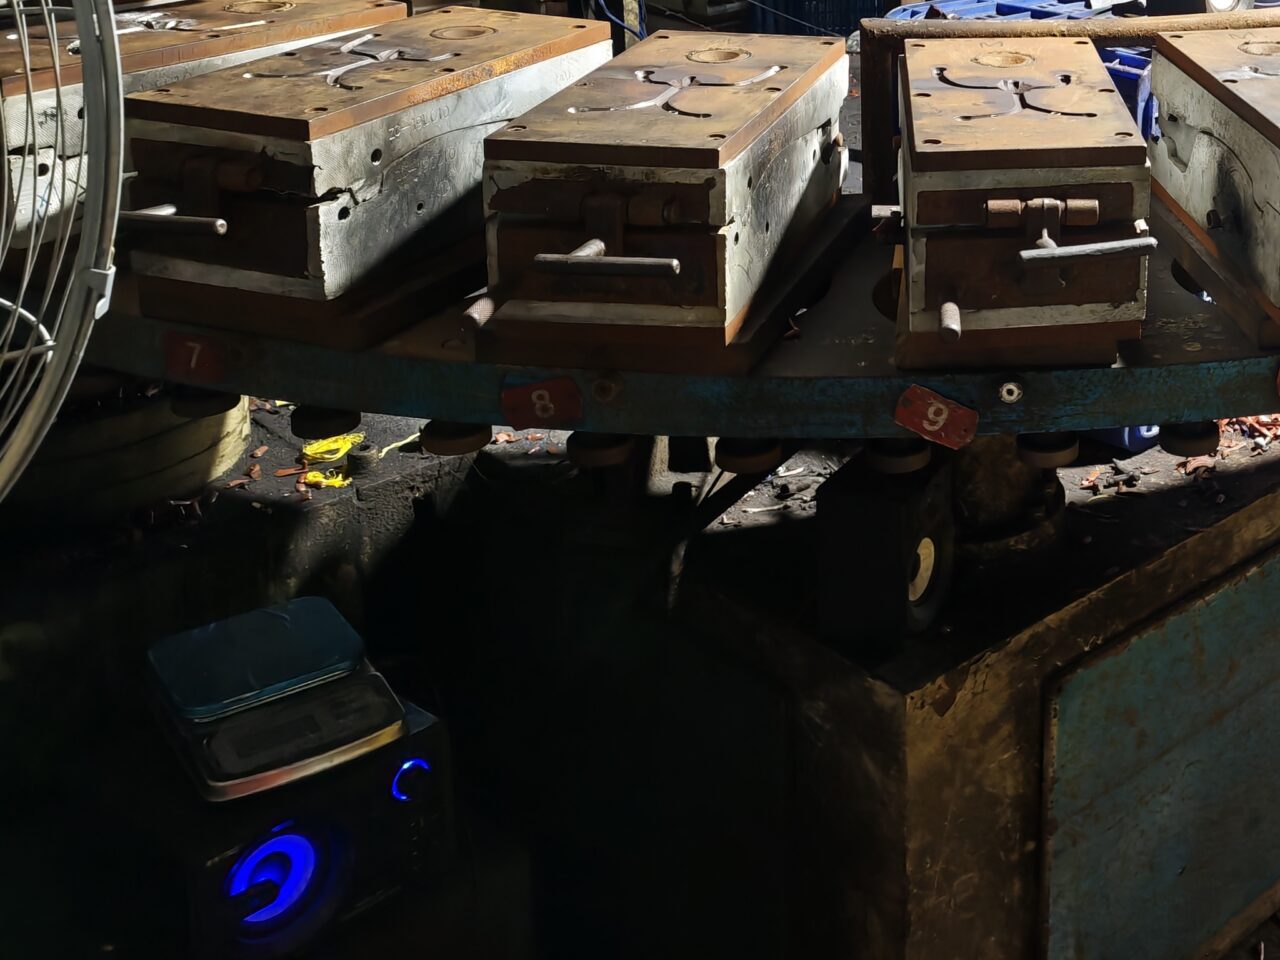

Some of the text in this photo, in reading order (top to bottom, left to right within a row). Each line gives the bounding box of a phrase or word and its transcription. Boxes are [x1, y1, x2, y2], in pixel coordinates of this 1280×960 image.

[184, 341, 202, 370] 7
[530, 388, 555, 419] 8
[921, 399, 949, 433] 9
